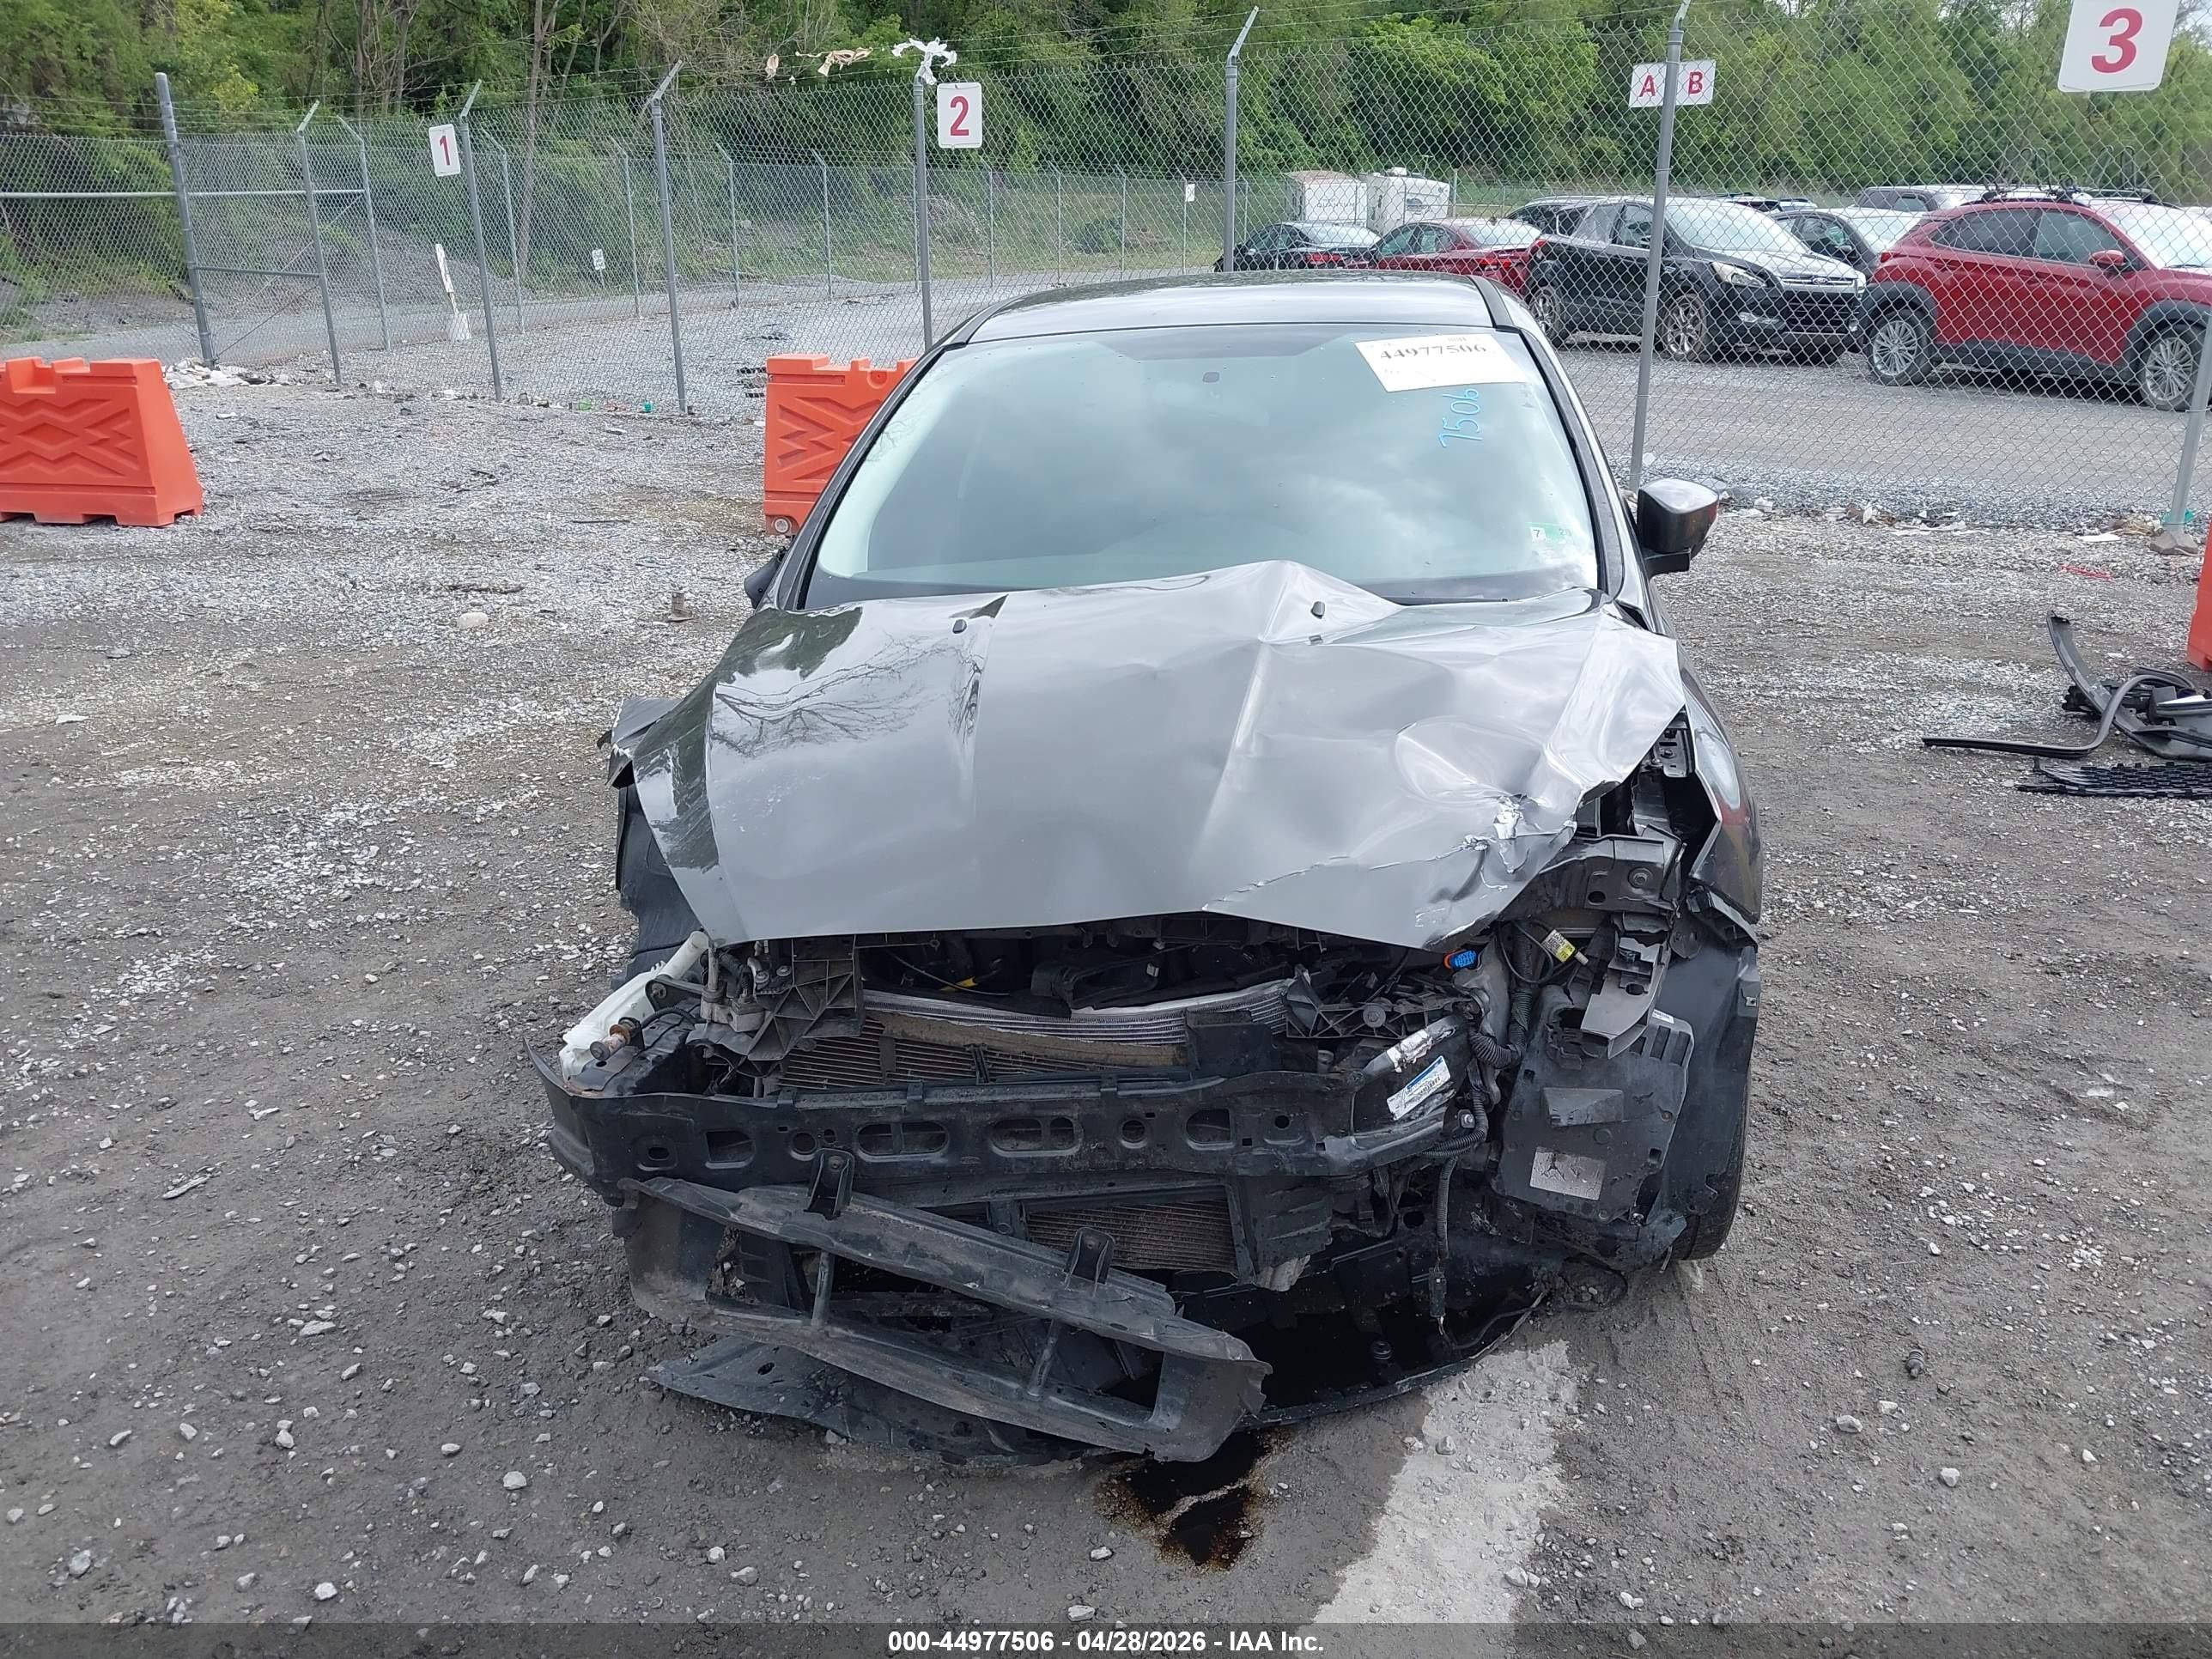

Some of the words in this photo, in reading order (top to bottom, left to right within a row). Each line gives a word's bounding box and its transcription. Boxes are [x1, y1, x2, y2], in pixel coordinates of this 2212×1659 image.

[2091, 9, 2143, 73] 3
[1639, 75, 1657, 97] A
[1688, 71, 1705, 94] B
[950, 95, 970, 137] 2
[439, 136, 451, 167] 1
[1380, 344, 1486, 359] 44977506
[1438, 388, 1483, 447] 7506
